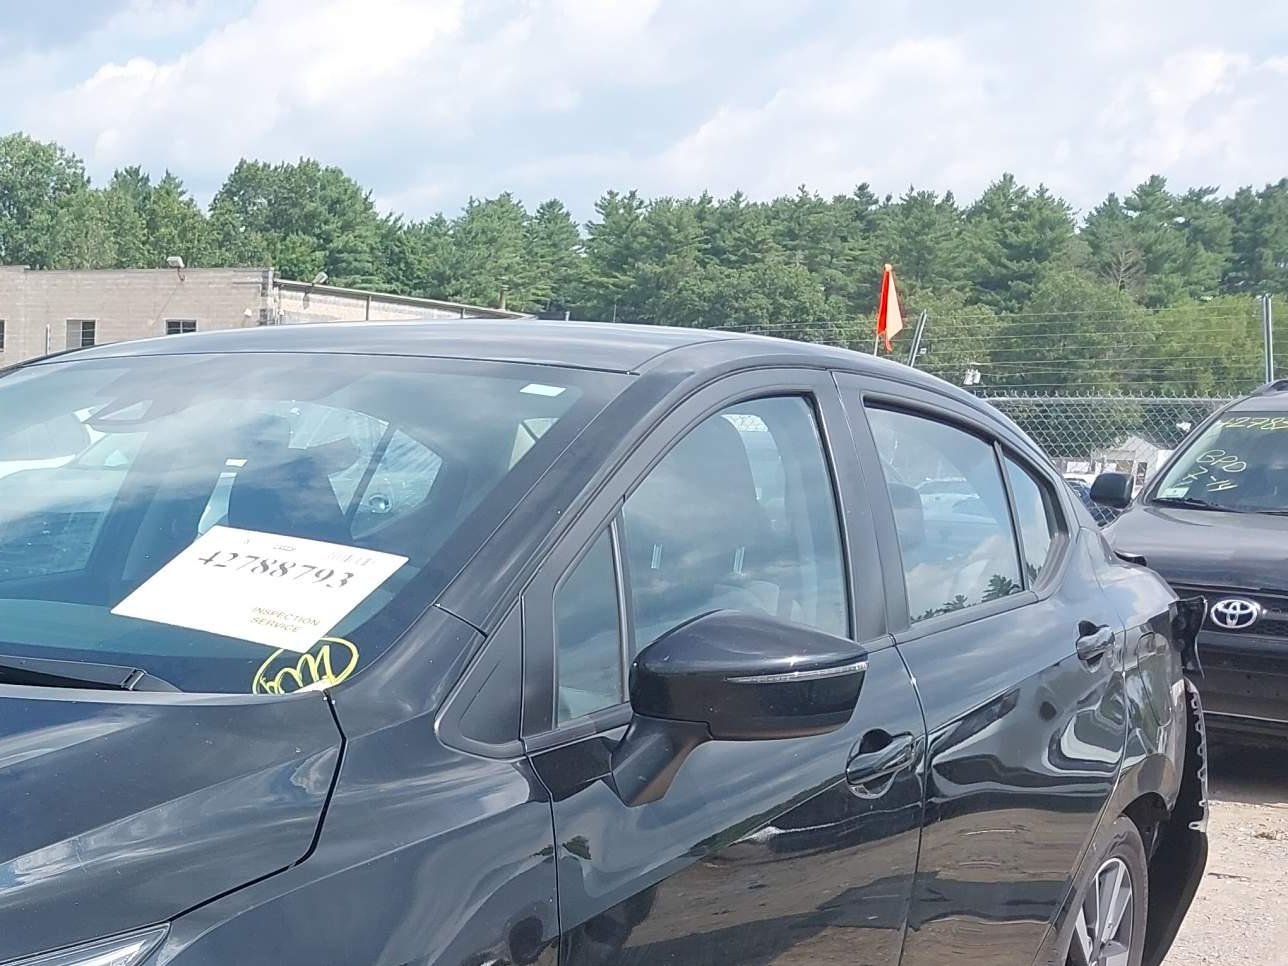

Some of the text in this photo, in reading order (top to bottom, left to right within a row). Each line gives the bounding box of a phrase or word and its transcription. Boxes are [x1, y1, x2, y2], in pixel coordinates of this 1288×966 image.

[197, 549, 355, 589] 42788793
[248, 616, 302, 634] SERVICE
[250, 605, 321, 627] INSPECTION
